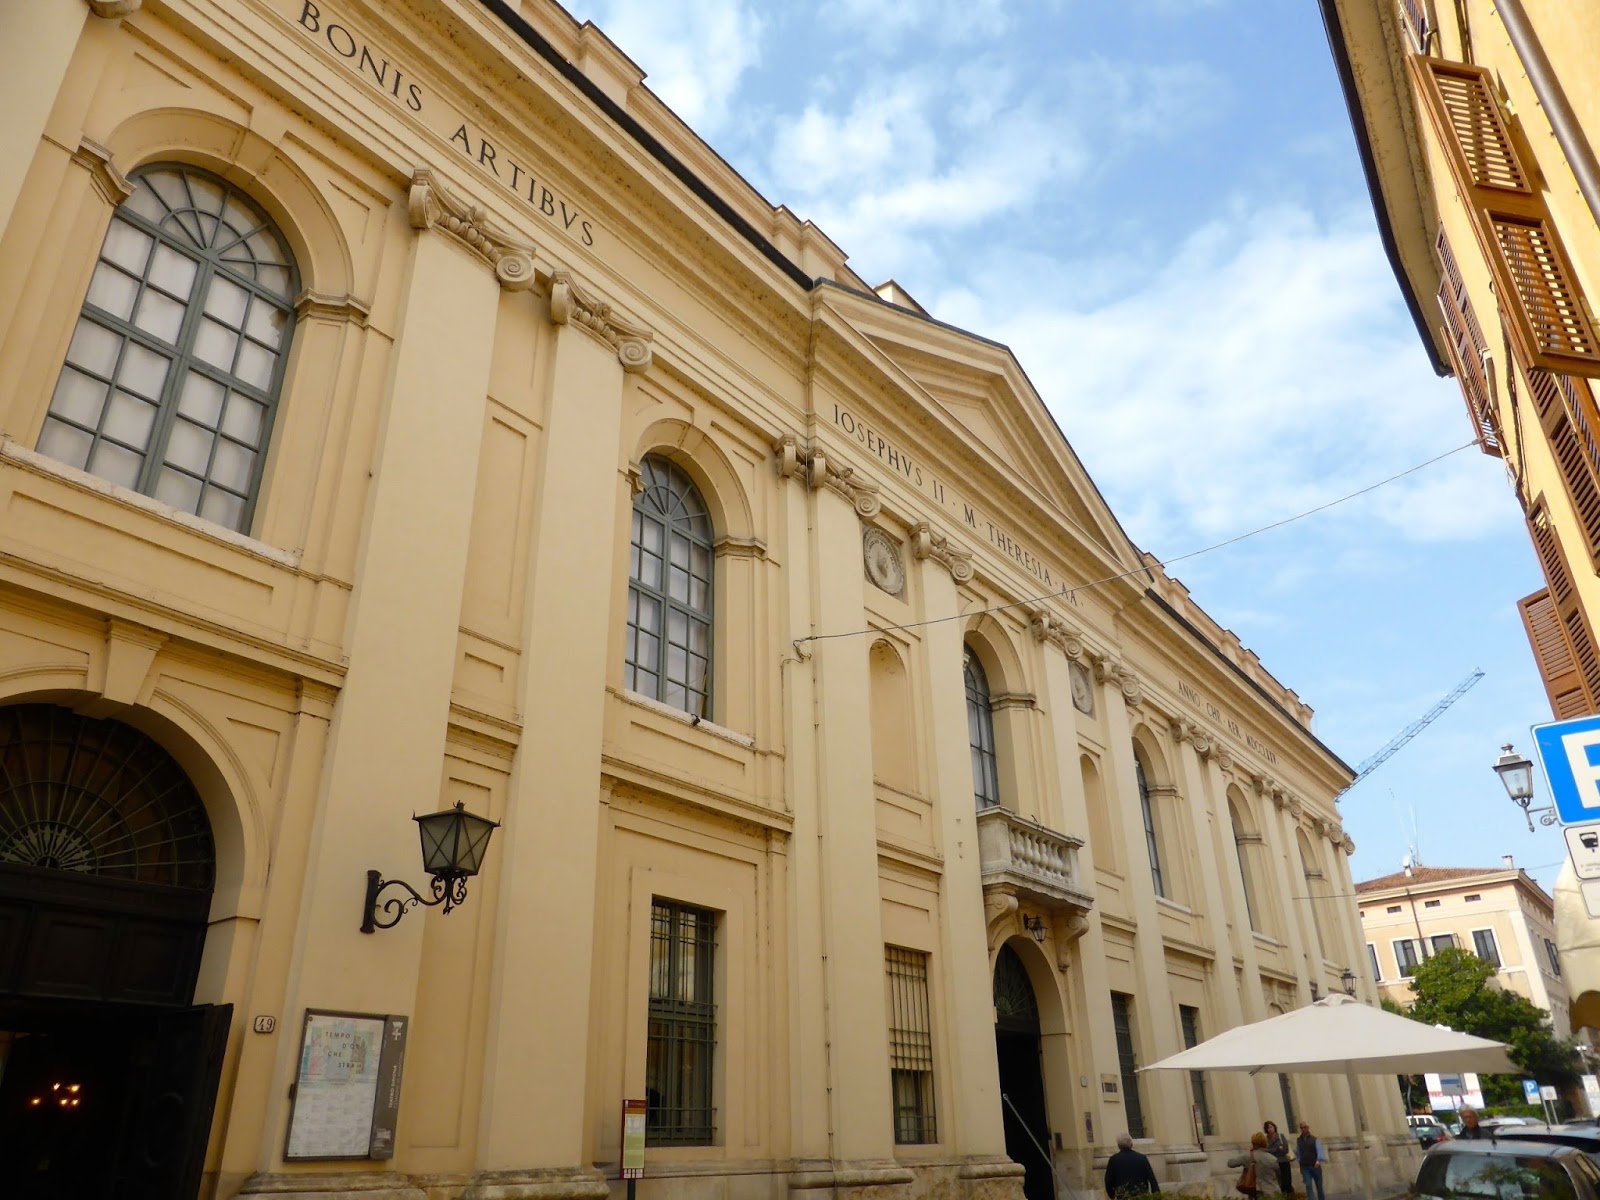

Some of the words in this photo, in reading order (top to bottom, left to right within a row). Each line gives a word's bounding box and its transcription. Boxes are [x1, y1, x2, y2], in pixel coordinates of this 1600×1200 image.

[297, 1, 422, 112] BONIS
[449, 124, 594, 247] ARTIBVS
[833, 404, 923, 486] IOSEPHVS
[932, 479, 945, 504] II
[986, 521, 1052, 587] THERESIA
[257, 1018, 273, 1031] 49
[325, 1031, 351, 1040] TEMPO
